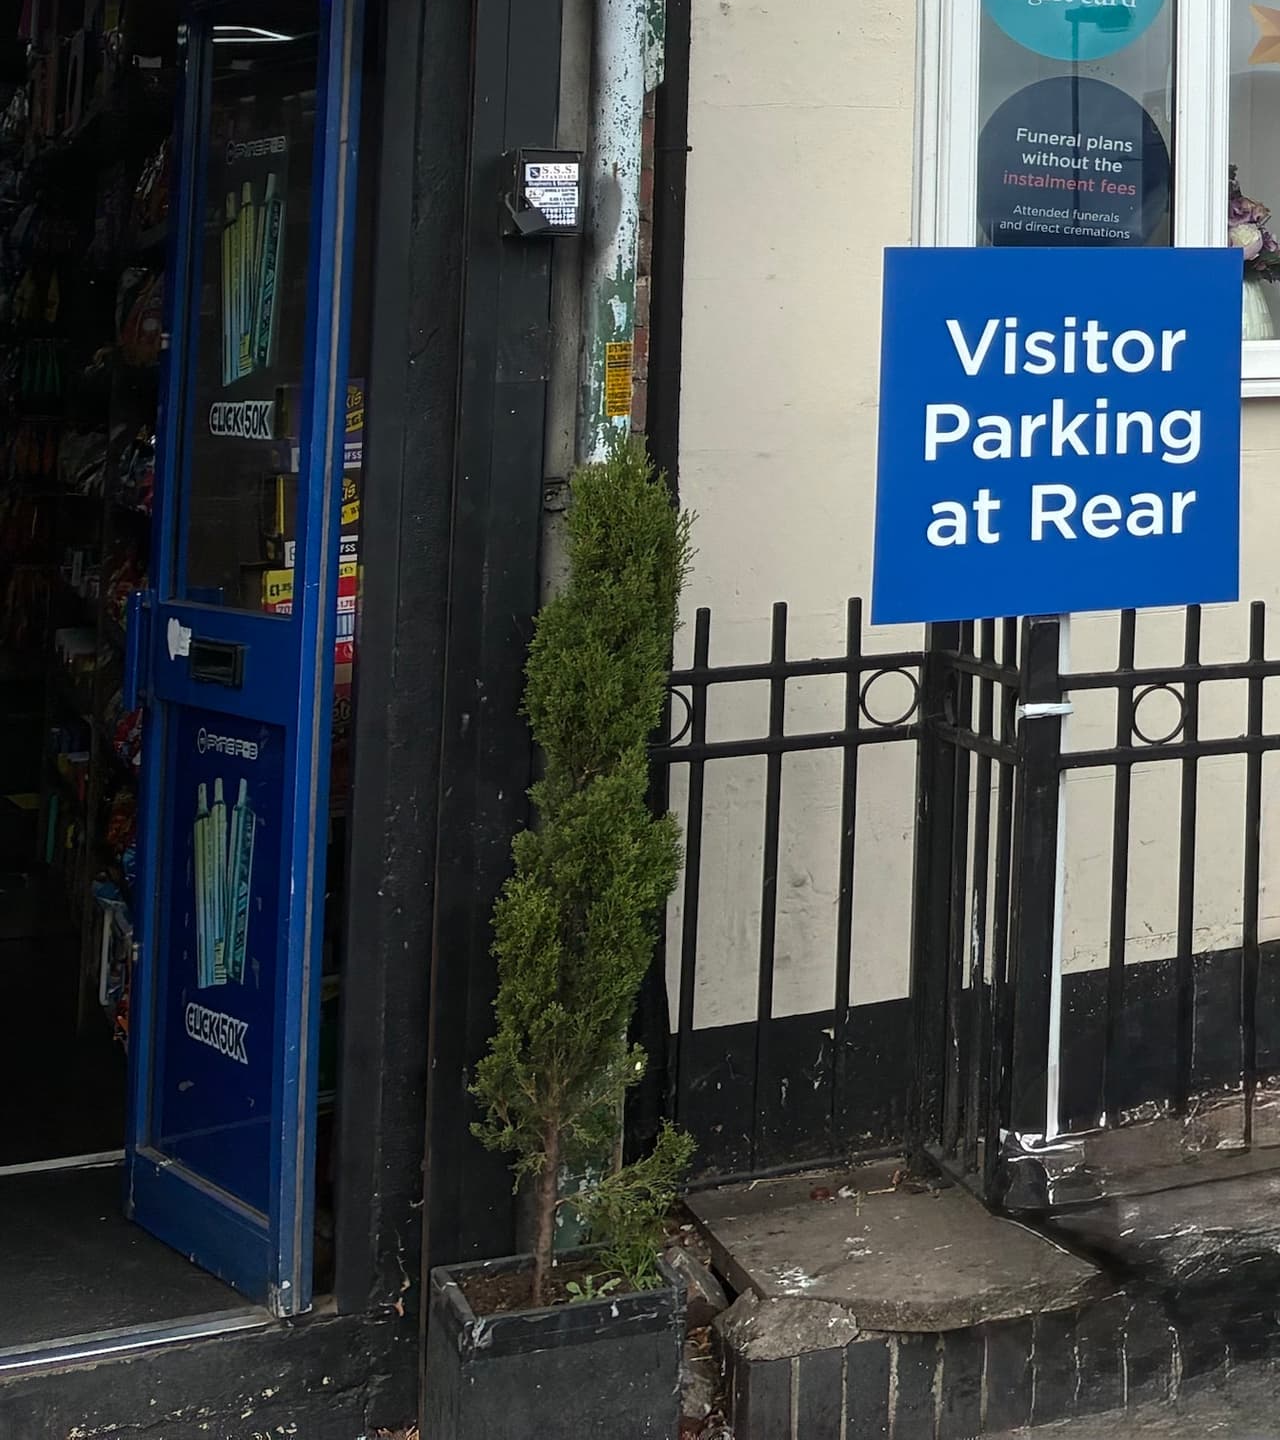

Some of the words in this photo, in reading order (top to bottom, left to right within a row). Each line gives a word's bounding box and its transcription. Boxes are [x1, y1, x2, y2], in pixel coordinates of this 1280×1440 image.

[1016, 127, 1081, 149] Funeral
[1086, 135, 1133, 157] plans
[1021, 150, 1089, 172] without
[1094, 155, 1123, 174] the
[1003, 170, 1095, 192] instalment
[1101, 178, 1137, 197] fees
[1000, 219, 1022, 231] and
[1025, 221, 1061, 235] direct
[1063, 225, 1131, 240] cremations
[1013, 204, 1070, 220] Attended
[1073, 208, 1120, 224] funerals
[946, 316, 1187, 377] Visitor
[209, 402, 243, 437] CLICK
[242, 401, 272, 439] 50K
[924, 397, 1202, 465] Parking
[925, 488, 1001, 547] at
[1030, 484, 1197, 542] Rear
[186, 1002, 219, 1050] CLICK
[218, 1014, 248, 1065] 50K
